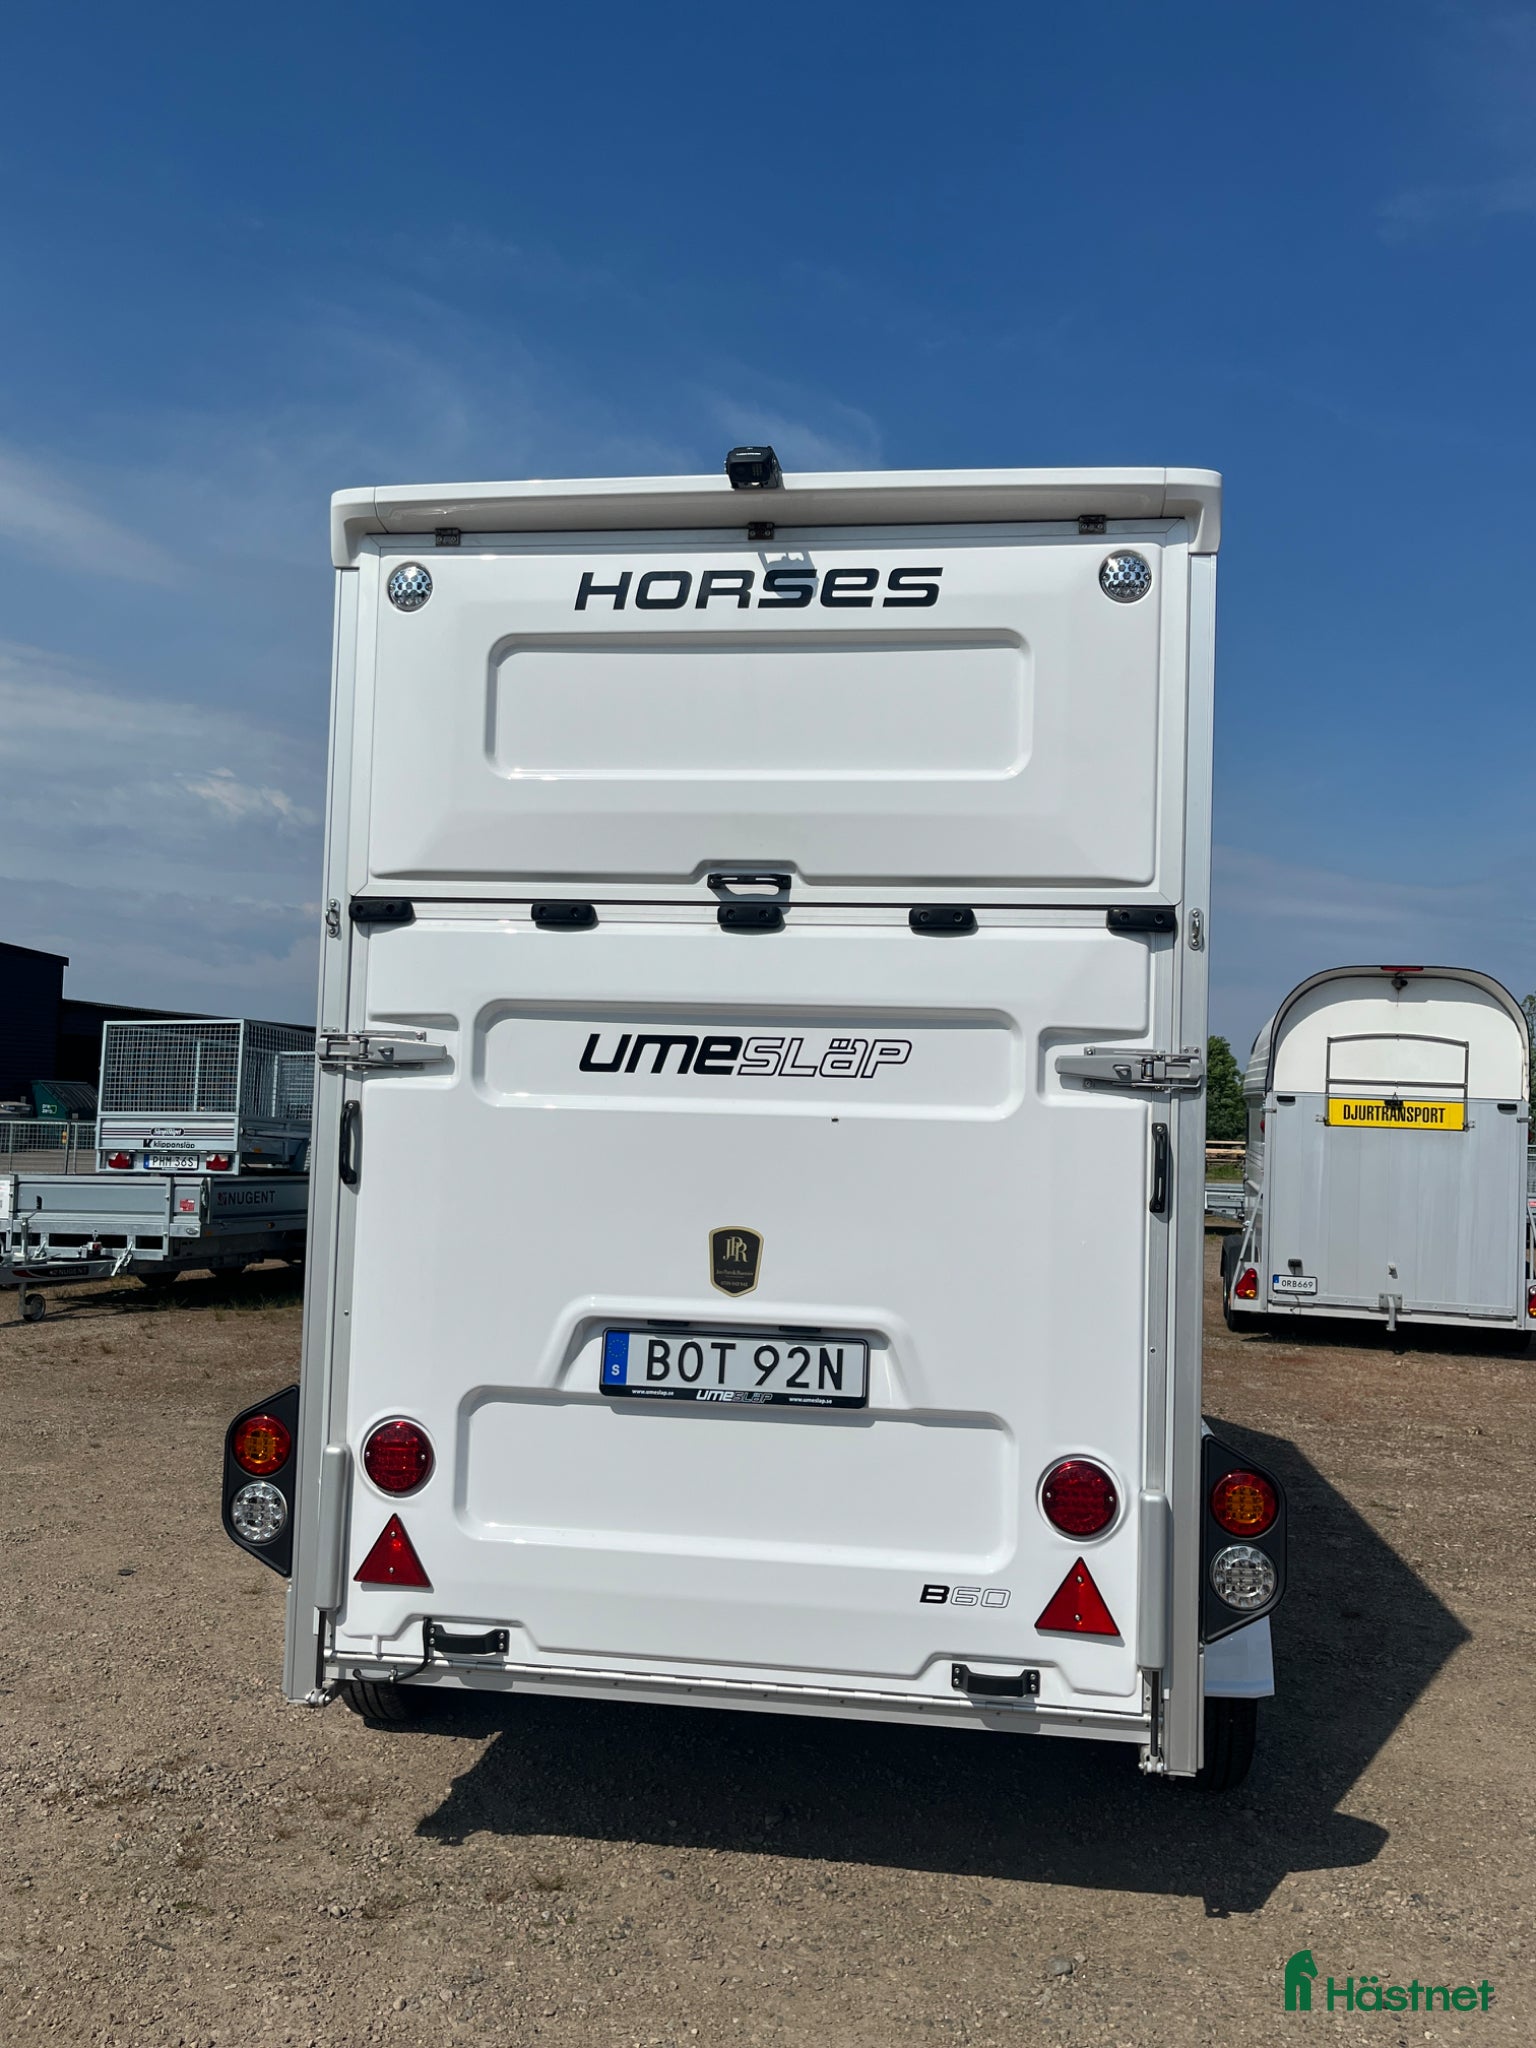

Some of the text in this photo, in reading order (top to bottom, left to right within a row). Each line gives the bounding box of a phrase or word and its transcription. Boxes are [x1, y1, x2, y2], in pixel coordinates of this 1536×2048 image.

[1343, 1105, 1446, 1124] DJURTRANSPORT
[152, 1156, 194, 1167] PHM 36S
[228, 1190, 276, 1206] NUGENT
[1281, 1280, 1314, 1288] ORB669
[611, 1364, 620, 1376] S
[646, 1339, 844, 1390] BOT 92N
[920, 1584, 1011, 1608] B60
